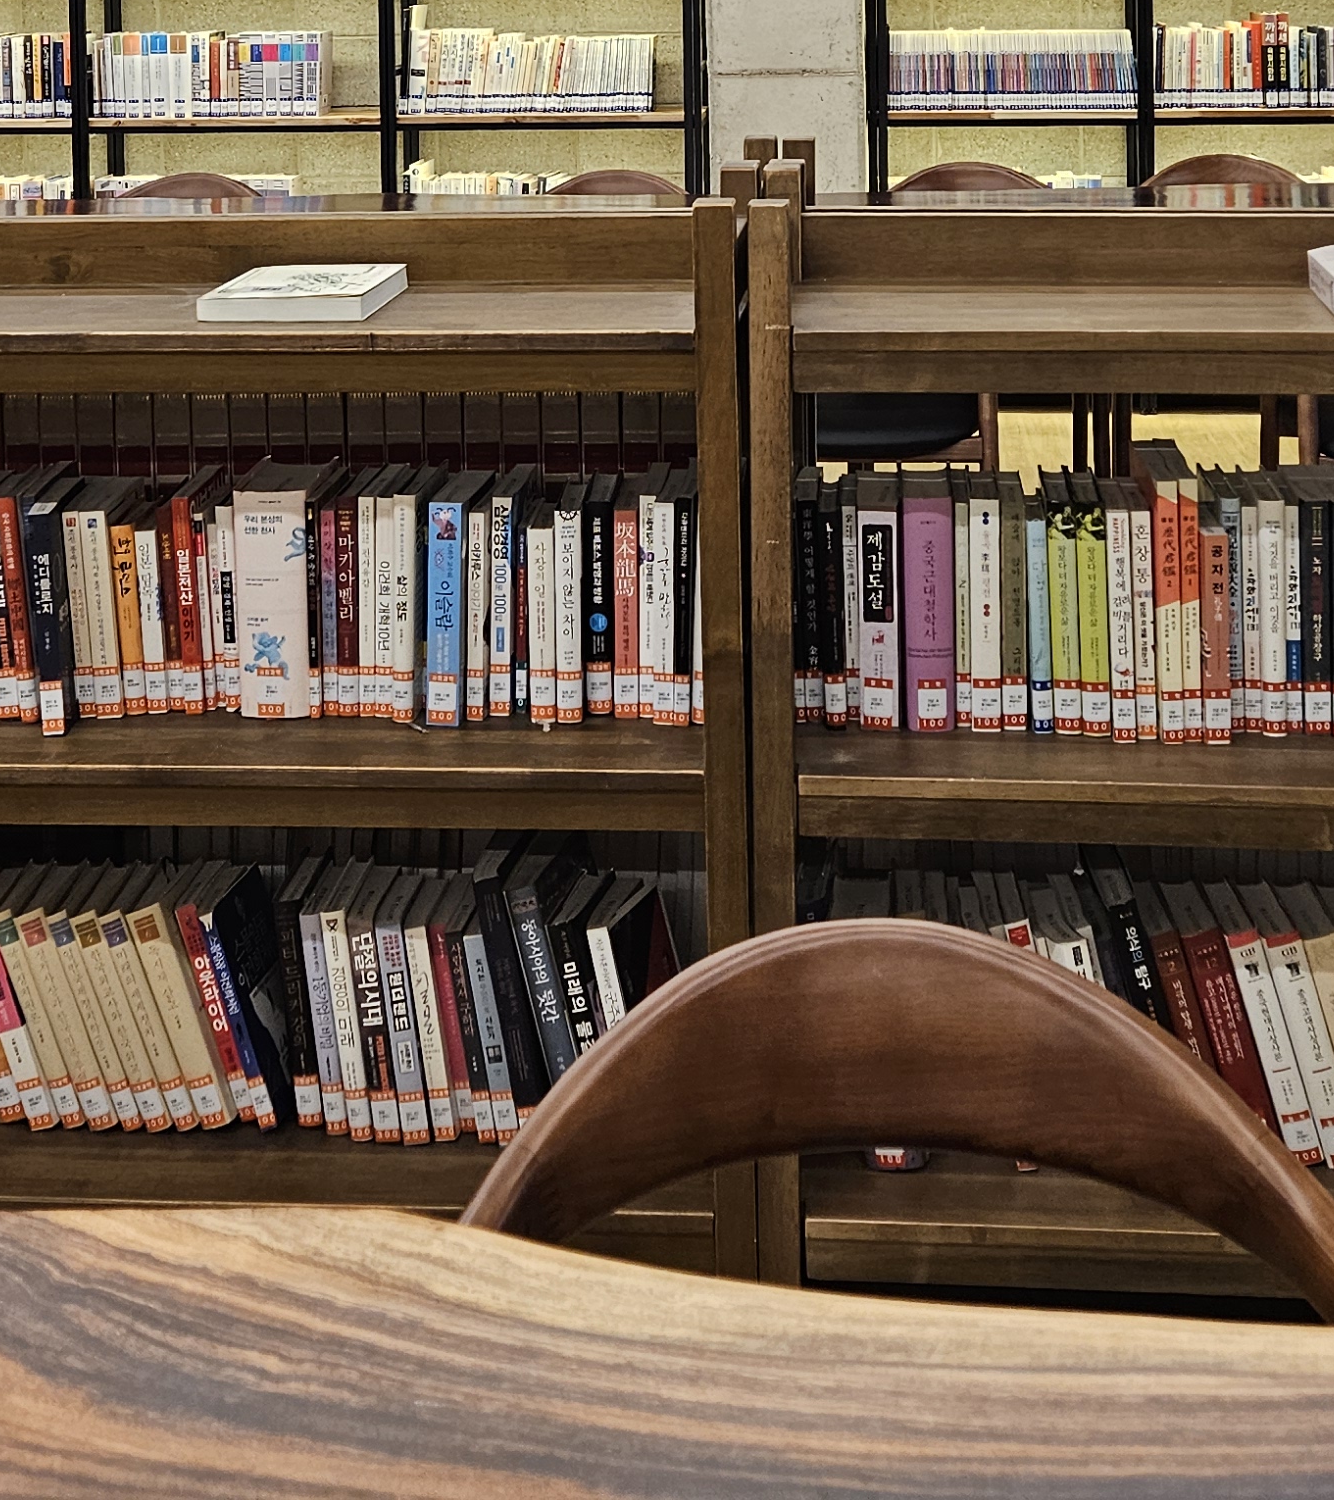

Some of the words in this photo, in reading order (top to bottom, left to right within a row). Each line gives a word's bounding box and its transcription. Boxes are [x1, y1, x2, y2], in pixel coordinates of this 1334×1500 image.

[493, 504, 511, 560] 삼성경영
[471, 543, 481, 581] 이카루스
[562, 543, 574, 580] 보이지
[615, 522, 637, 597] 坂本龍馬
[867, 531, 885, 610] 제감도설
[1134, 525, 1150, 584] 혼창통
[1211, 545, 1224, 595] 공자전
[1312, 557, 1322, 575] 노자
[38, 554, 53, 614] 에디톨로지
[177, 549, 193, 605] 일본전산
[338, 534, 355, 622] 마키아벨리
[379, 561, 391, 596] 이건희
[397, 574, 408, 596] 삶의
[397, 600, 408, 622] 정도
[435, 581, 454, 631] 이슬람
[471, 582, 481, 612] 이야기
[562, 584, 574, 609] 않는
[182, 607, 194, 641] 이야기
[378, 601, 390, 651] 개혁10년
[563, 614, 574, 640] 차이
[431, 712, 453, 720] 300
[868, 718, 888, 726] 100
[1005, 716, 1025, 724] 100
[1115, 730, 1136, 738] 100
[351, 931, 379, 989] 단절의
[1124, 926, 1145, 963] 의식의
[521, 919, 549, 986] 동아시아의
[536, 989, 556, 1024] 뒷간
[1133, 964, 1152, 991] 탐구
[193, 956, 229, 1032] 아웃라이어
[360, 990, 384, 1027] 시대
[339, 1018, 355, 1048] 미래
[328, 1121, 347, 1130] 300
